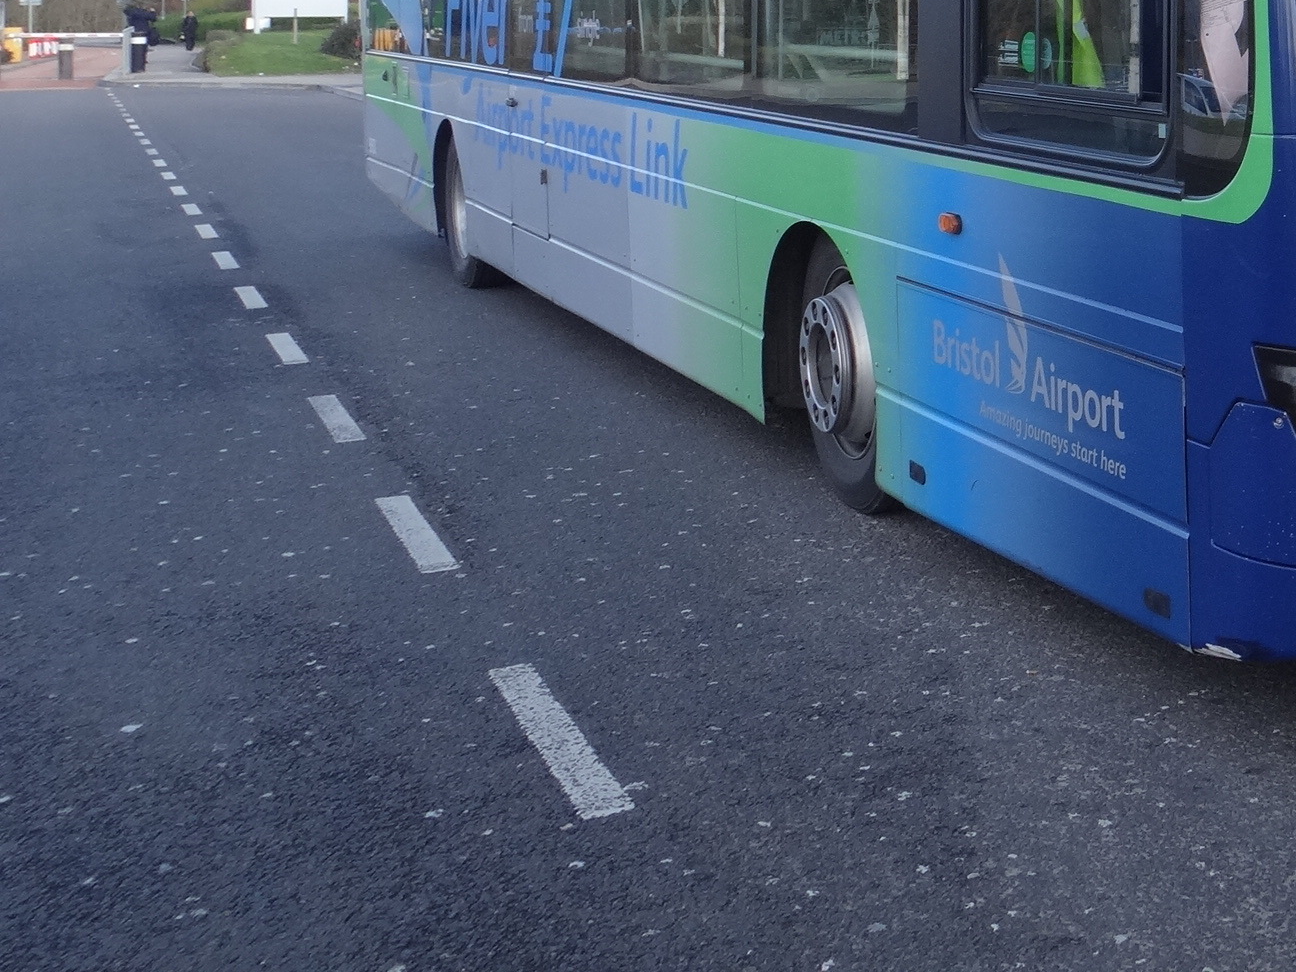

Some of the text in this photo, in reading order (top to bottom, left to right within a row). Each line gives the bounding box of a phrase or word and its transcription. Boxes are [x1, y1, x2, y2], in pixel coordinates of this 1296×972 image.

[475, 82, 688, 209] Airport Express Link
[933, 319, 1126, 440] Bristol Airport
[979, 400, 1127, 480] Amazing journeys start here
